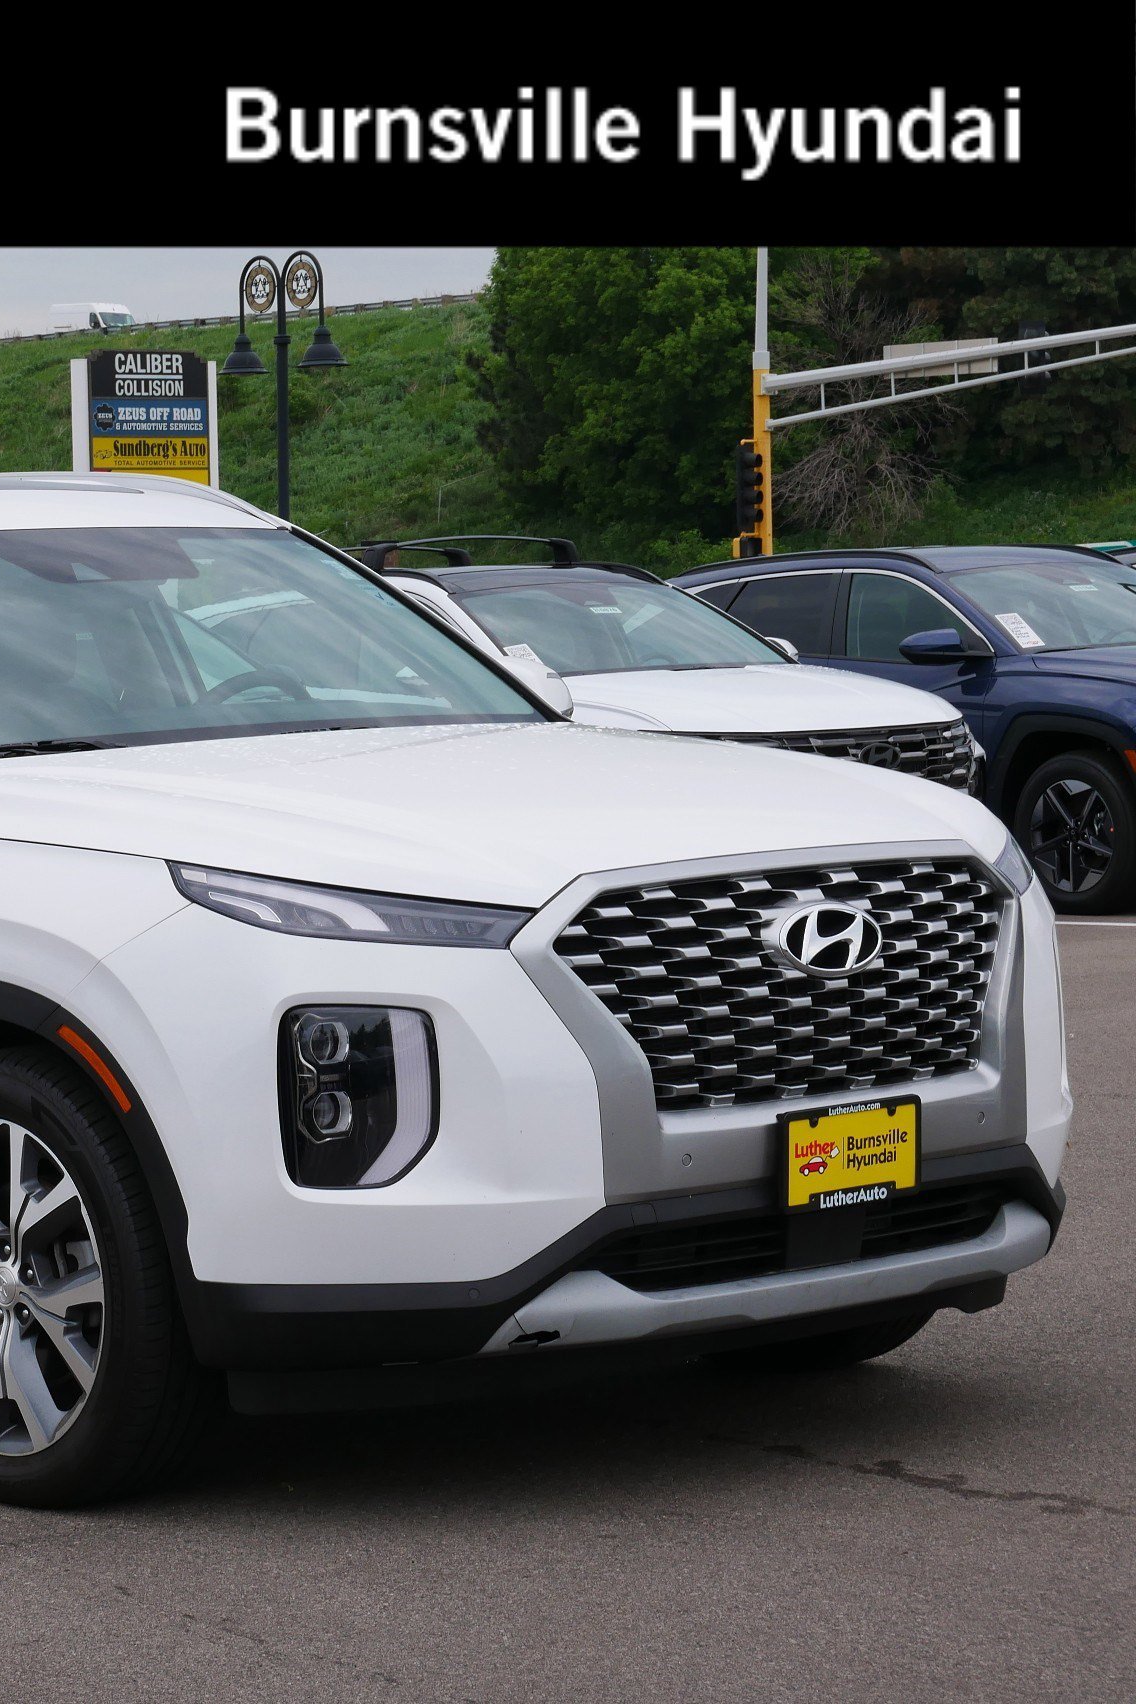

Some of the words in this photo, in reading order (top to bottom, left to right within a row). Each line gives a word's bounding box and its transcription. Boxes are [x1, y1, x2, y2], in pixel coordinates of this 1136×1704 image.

[114, 353, 184, 374] CALIBER
[115, 379, 184, 396] COLLISION
[117, 407, 146, 421] ZEUS
[149, 407, 171, 421] OFF
[173, 407, 202, 421] ROAD
[115, 422, 121, 431] &
[122, 422, 168, 431] AUTOMOTIVE
[169, 422, 204, 431] SERVICES
[113, 439, 178, 459] Sundberg's
[828, 1101, 881, 1117] LutherAuto.com
[846, 1128, 908, 1151] Burnsville
[794, 1140, 836, 1159] Luther
[846, 1146, 897, 1171] Hyundai
[820, 1186, 888, 1209] LutherAuto
